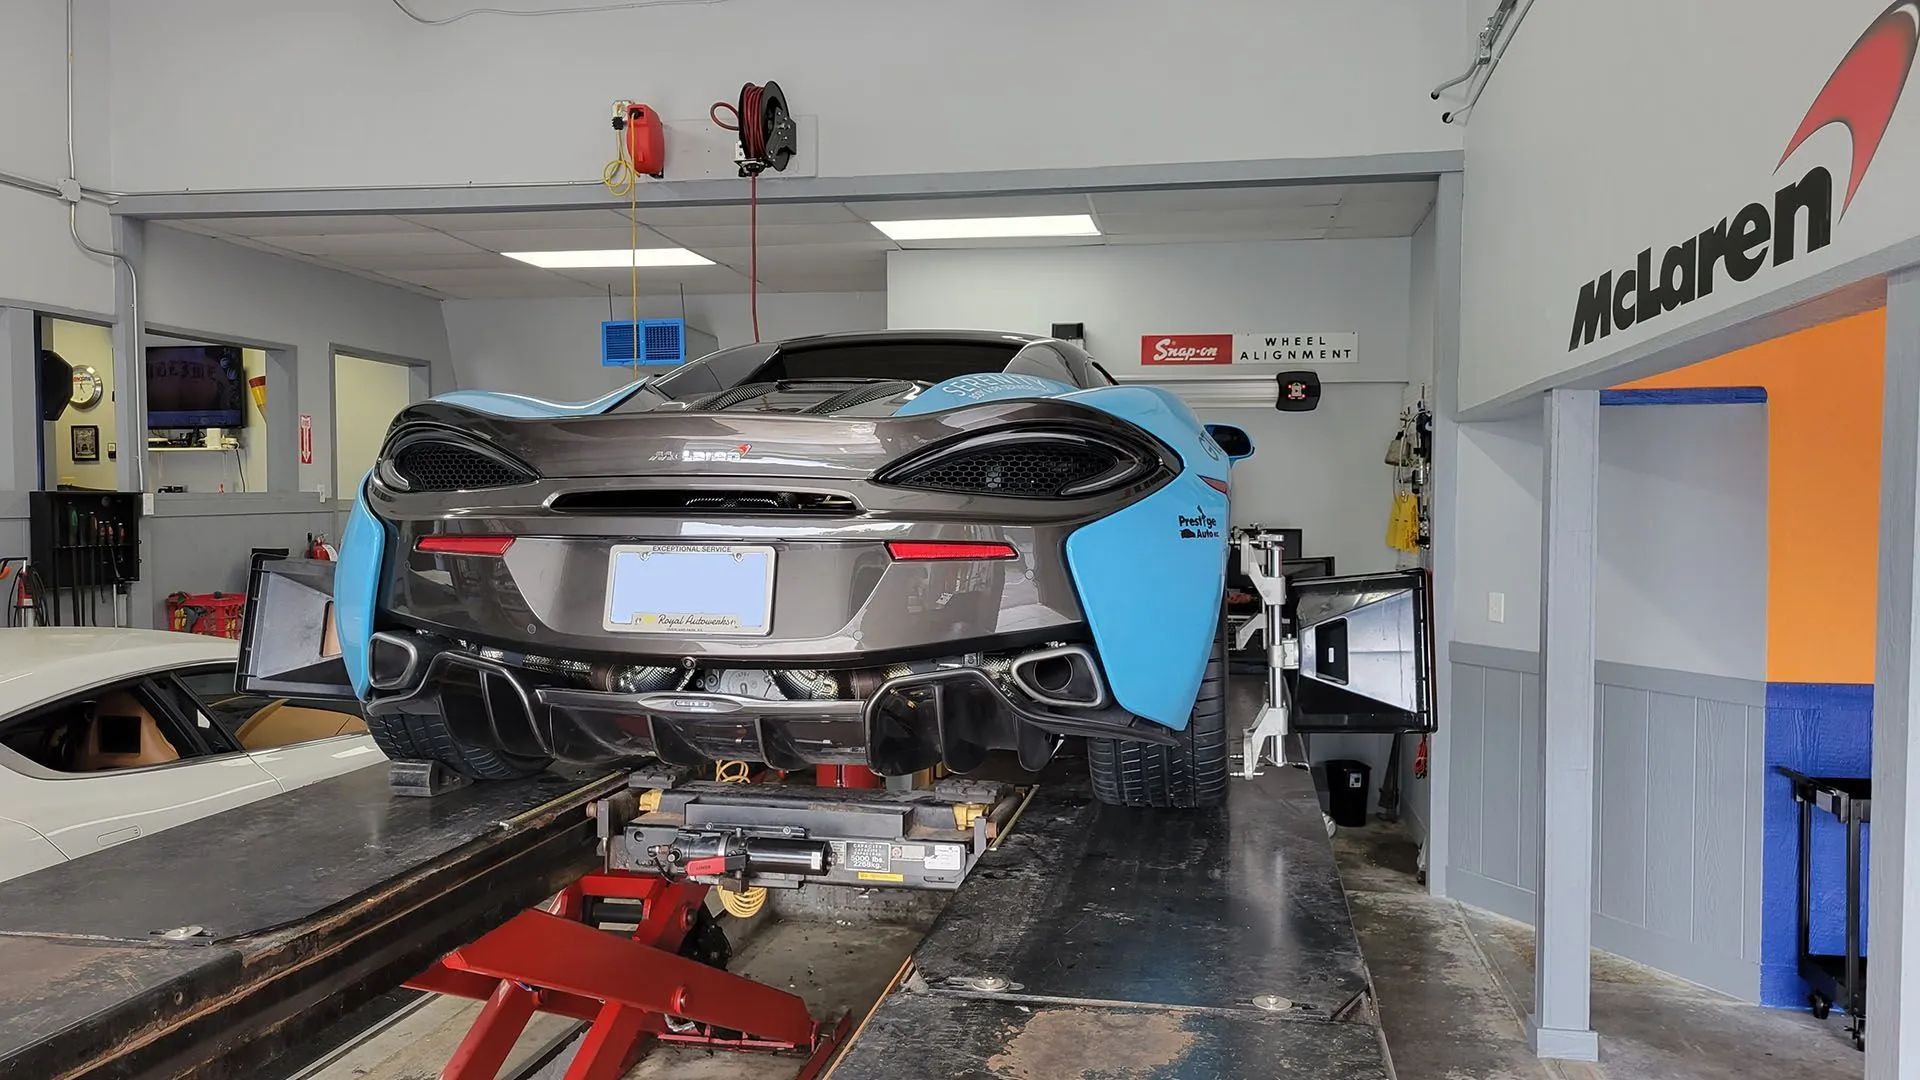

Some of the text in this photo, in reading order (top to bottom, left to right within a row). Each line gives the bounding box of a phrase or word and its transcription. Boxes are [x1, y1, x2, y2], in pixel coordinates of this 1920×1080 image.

[1568, 166, 1832, 352] McLaren
[1265, 336, 1326, 347] WHEEL
[1153, 338, 1218, 361] Snap-on
[1239, 349, 1352, 361] ALIGNMENT
[942, 375, 1050, 397] SERENITY
[1178, 512, 1217, 529] Prestige
[1196, 529, 1214, 539] Auto
[658, 614, 683, 628] Royal
